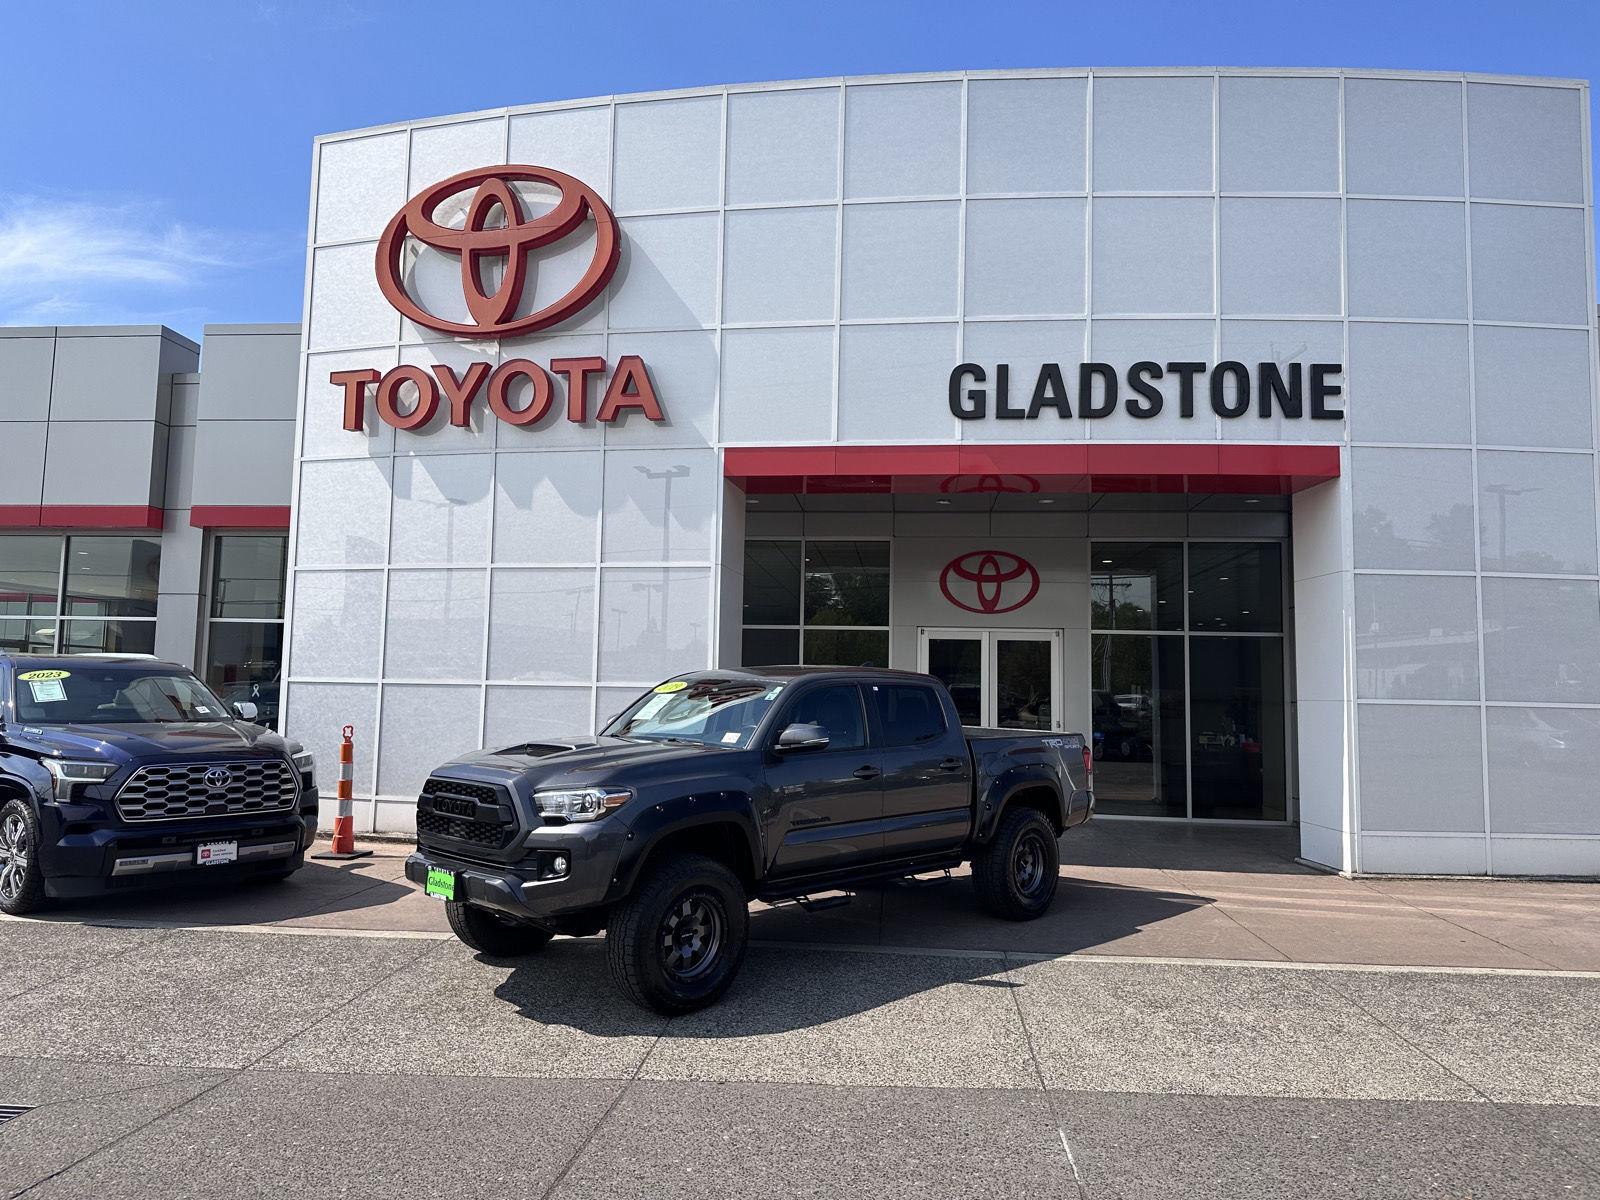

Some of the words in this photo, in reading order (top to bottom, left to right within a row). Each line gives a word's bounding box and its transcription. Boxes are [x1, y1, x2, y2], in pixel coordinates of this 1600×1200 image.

[330, 355, 665, 432] TOYOTA
[948, 361, 1344, 420] GLADSTONE
[436, 797, 473, 816] TOYOTA
